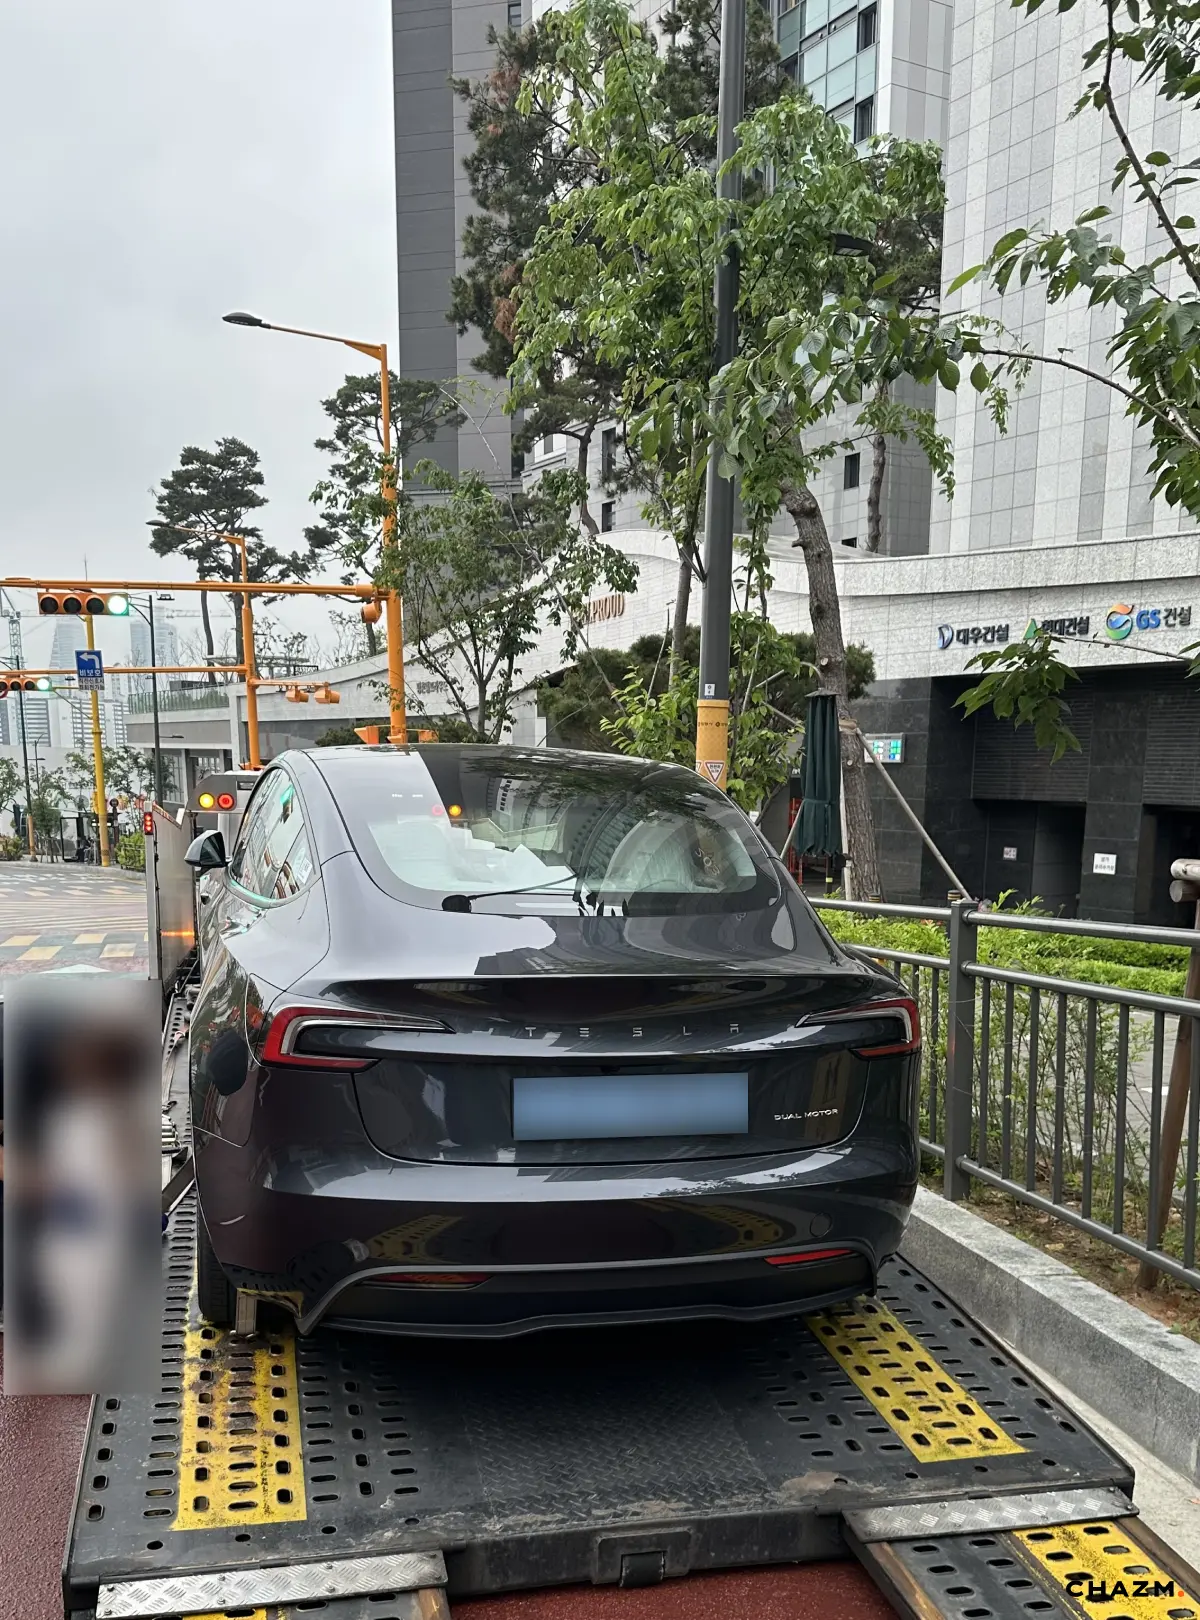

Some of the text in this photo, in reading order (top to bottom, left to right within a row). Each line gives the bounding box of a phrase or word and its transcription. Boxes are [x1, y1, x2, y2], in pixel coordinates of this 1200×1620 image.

[955, 624, 1009, 645] 대우건설
[79, 669, 101, 677] 비보호
[525, 1023, 740, 1037] TESLA
[774, 1108, 839, 1121] DUAL MOTOR
